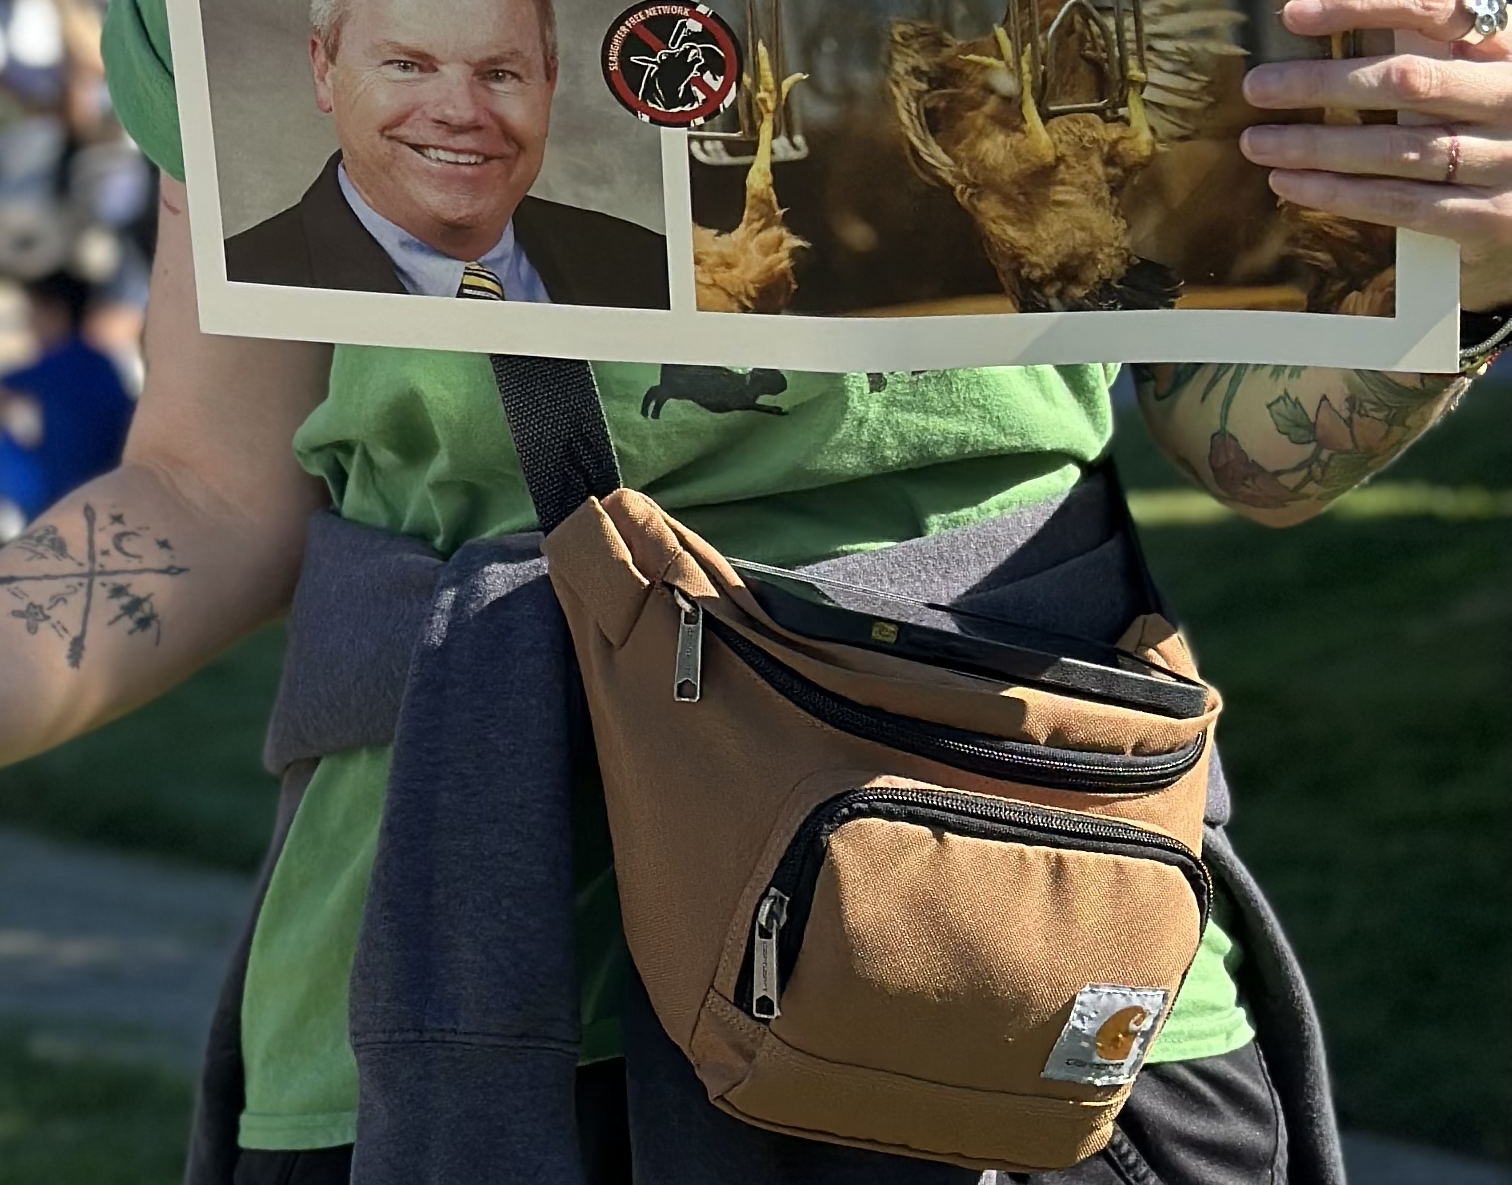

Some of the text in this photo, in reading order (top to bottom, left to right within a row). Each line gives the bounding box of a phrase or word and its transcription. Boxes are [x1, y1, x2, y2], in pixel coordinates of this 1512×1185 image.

[609, 5, 690, 71] SLAUGHTER FREE NETWORK
